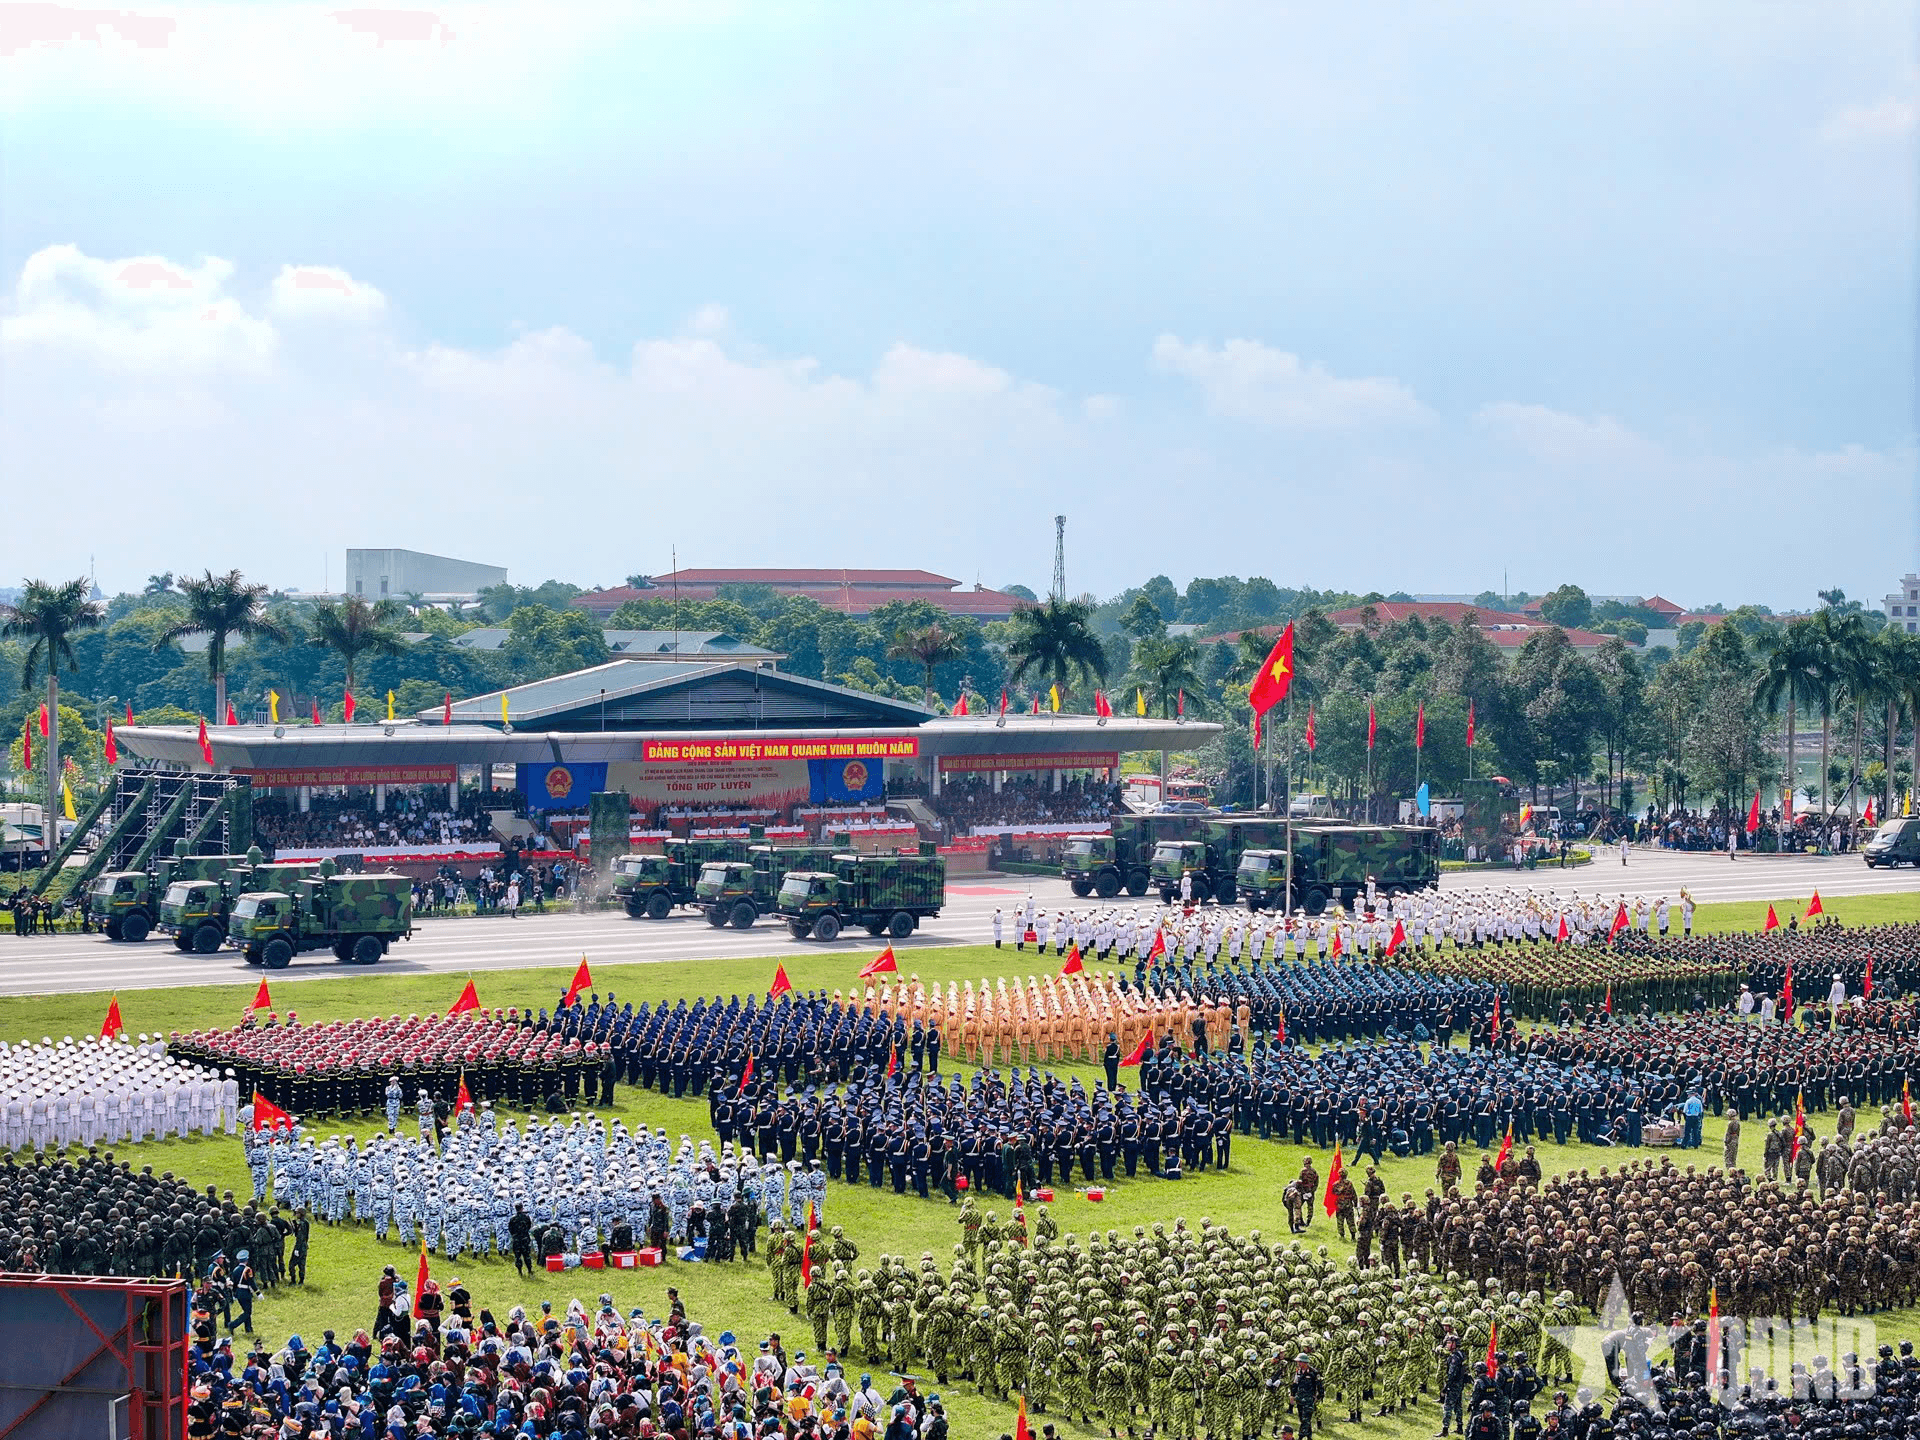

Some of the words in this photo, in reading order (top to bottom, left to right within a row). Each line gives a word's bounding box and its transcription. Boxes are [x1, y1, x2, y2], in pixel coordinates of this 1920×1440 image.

[649, 742, 679, 758] ĐẢNG
[682, 744, 711, 760] CỘNG
[715, 741, 736, 758] SẢN
[739, 743, 762, 759] VIỆT
[764, 745, 789, 757] NAM
[792, 744, 827, 757] QUANG
[830, 743, 854, 756] VINH
[857, 741, 887, 755] MUÔN
[890, 740, 914, 754] NĂM
[667, 780, 692, 791] TỔNG
[697, 782, 716, 791] HỢP
[721, 781, 751, 790] LUYỆN
